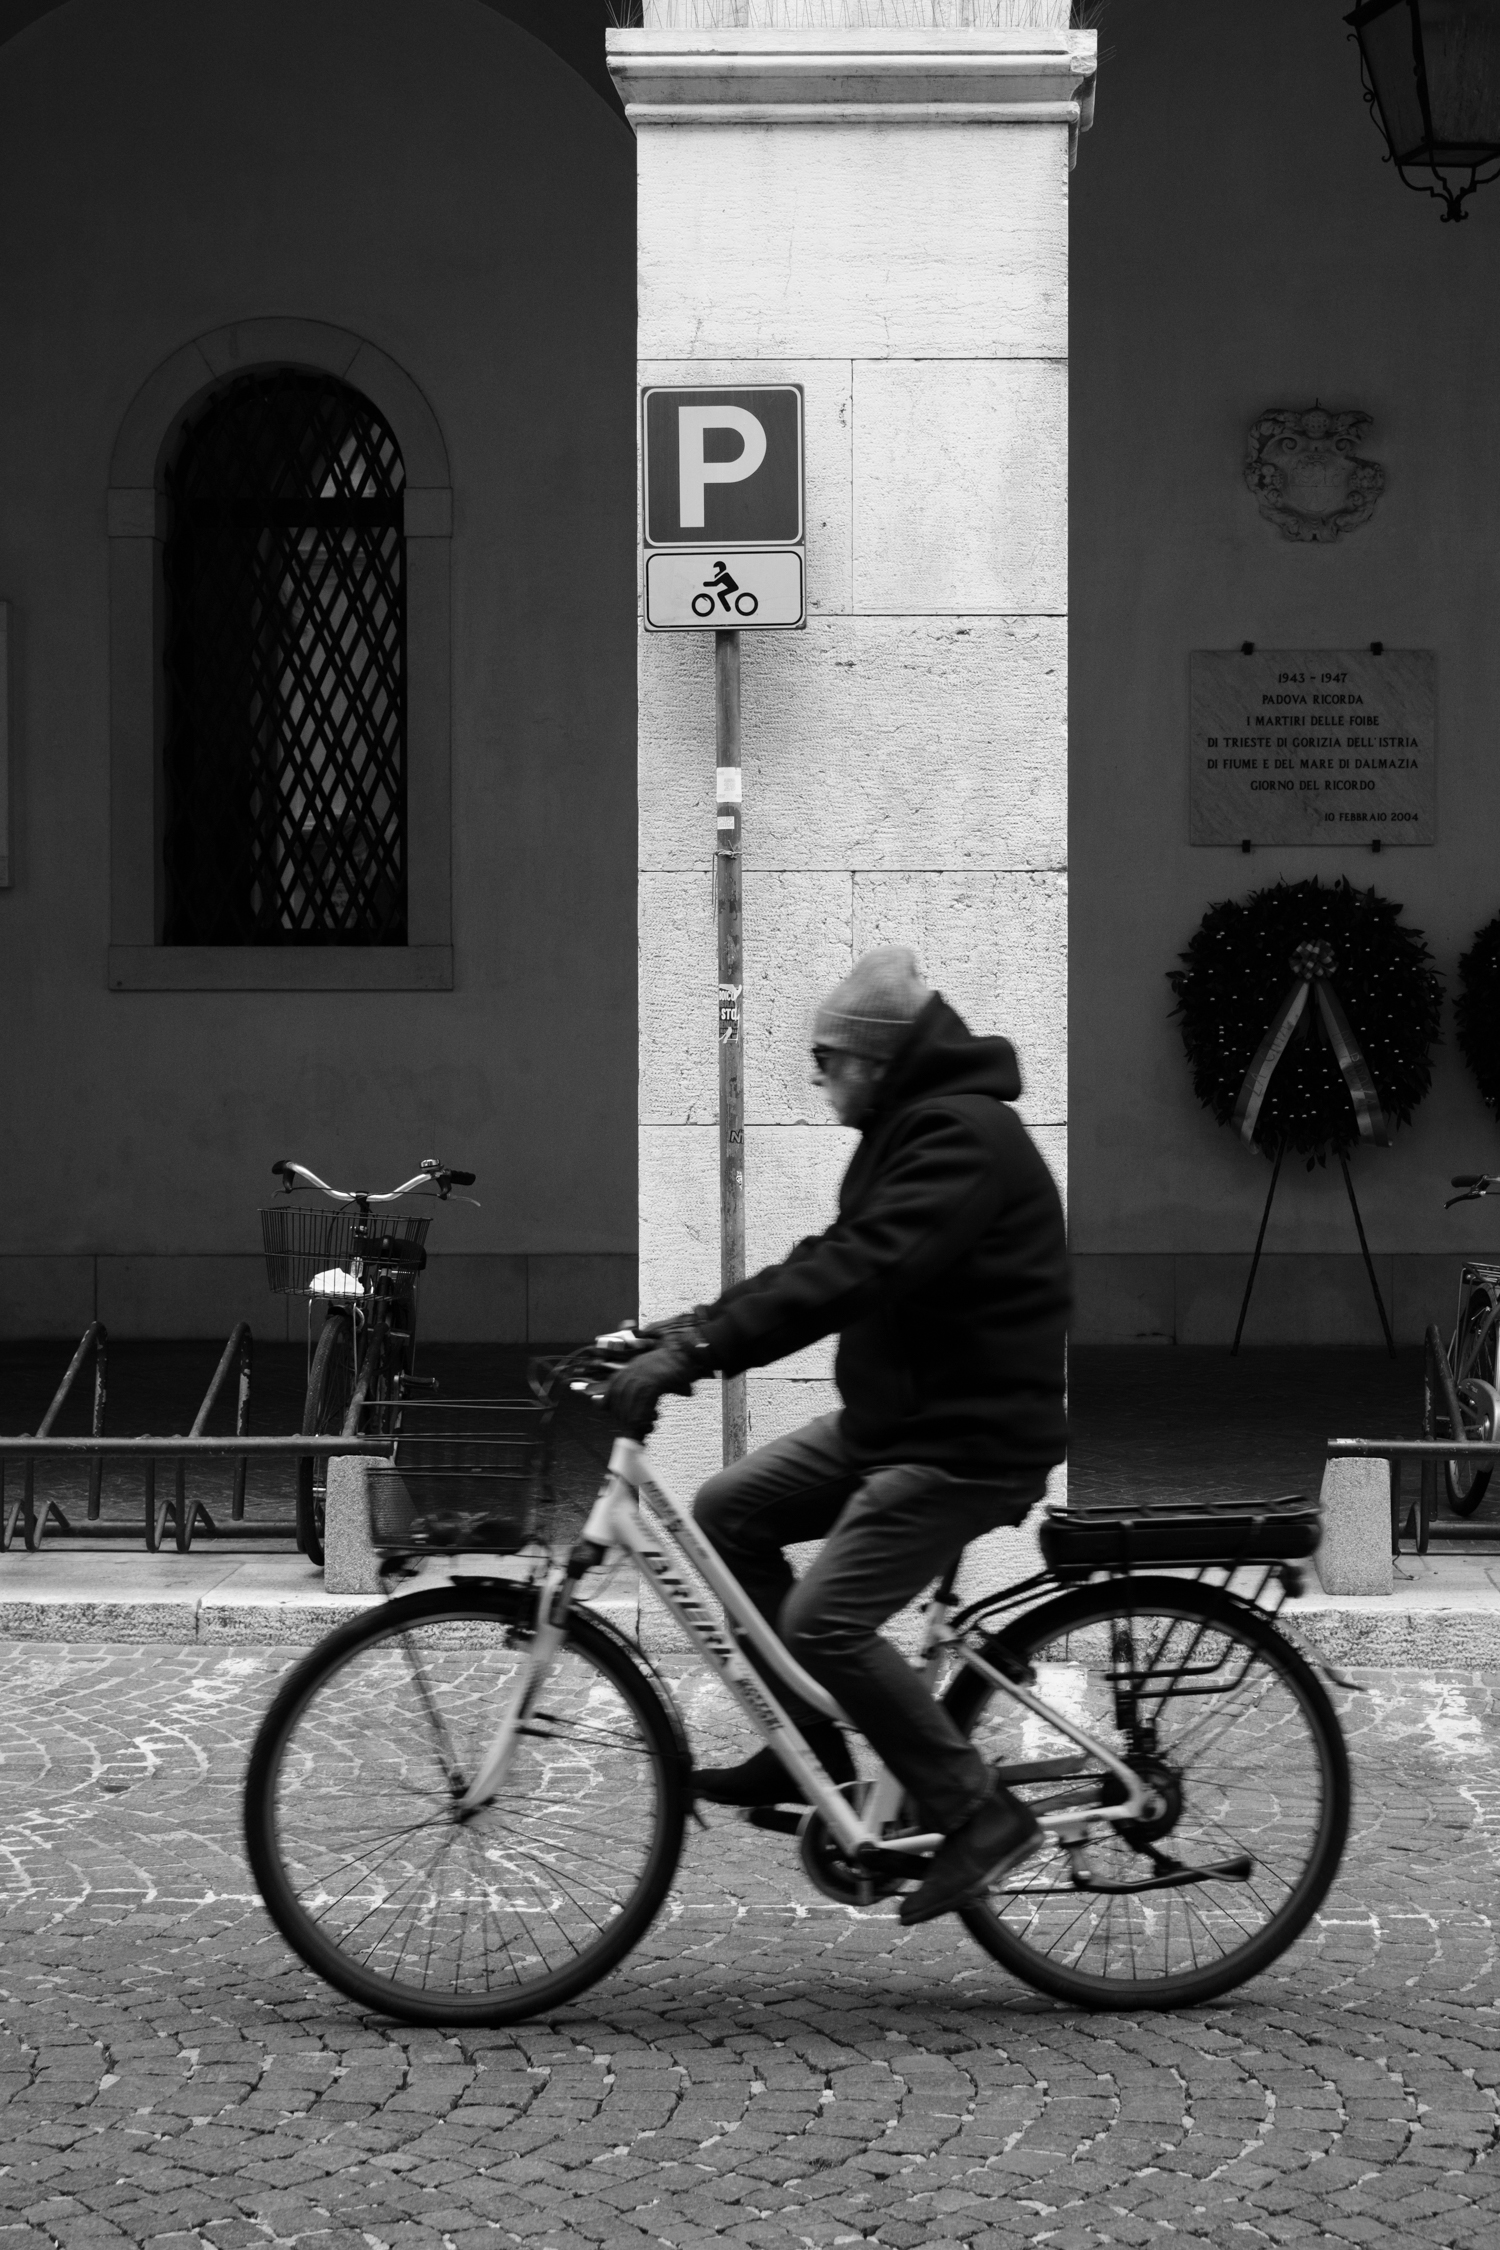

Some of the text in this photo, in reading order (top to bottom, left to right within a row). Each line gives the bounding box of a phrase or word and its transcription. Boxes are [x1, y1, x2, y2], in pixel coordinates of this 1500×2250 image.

[679, 405, 767, 528] P
[1278, 673, 1305, 683] 1943
[1321, 673, 1348, 683] 1947
[1263, 694, 1363, 704] PADOVA RICORDA
[1247, 716, 1379, 726] I MARTIRI DELLE FOIBE
[1208, 737, 1418, 748] DI TRIESTE DI GORIZIA DELL'ISTRIA
[1208, 759, 1418, 769] DI FIUME E DEL MARE DI DALMAZIA
[1251, 780, 1375, 790] GIORNO DEL RICORDO
[1325, 813, 1418, 821] 10 FEBBRAIO 2004
[720, 1008, 738, 1021] STO
